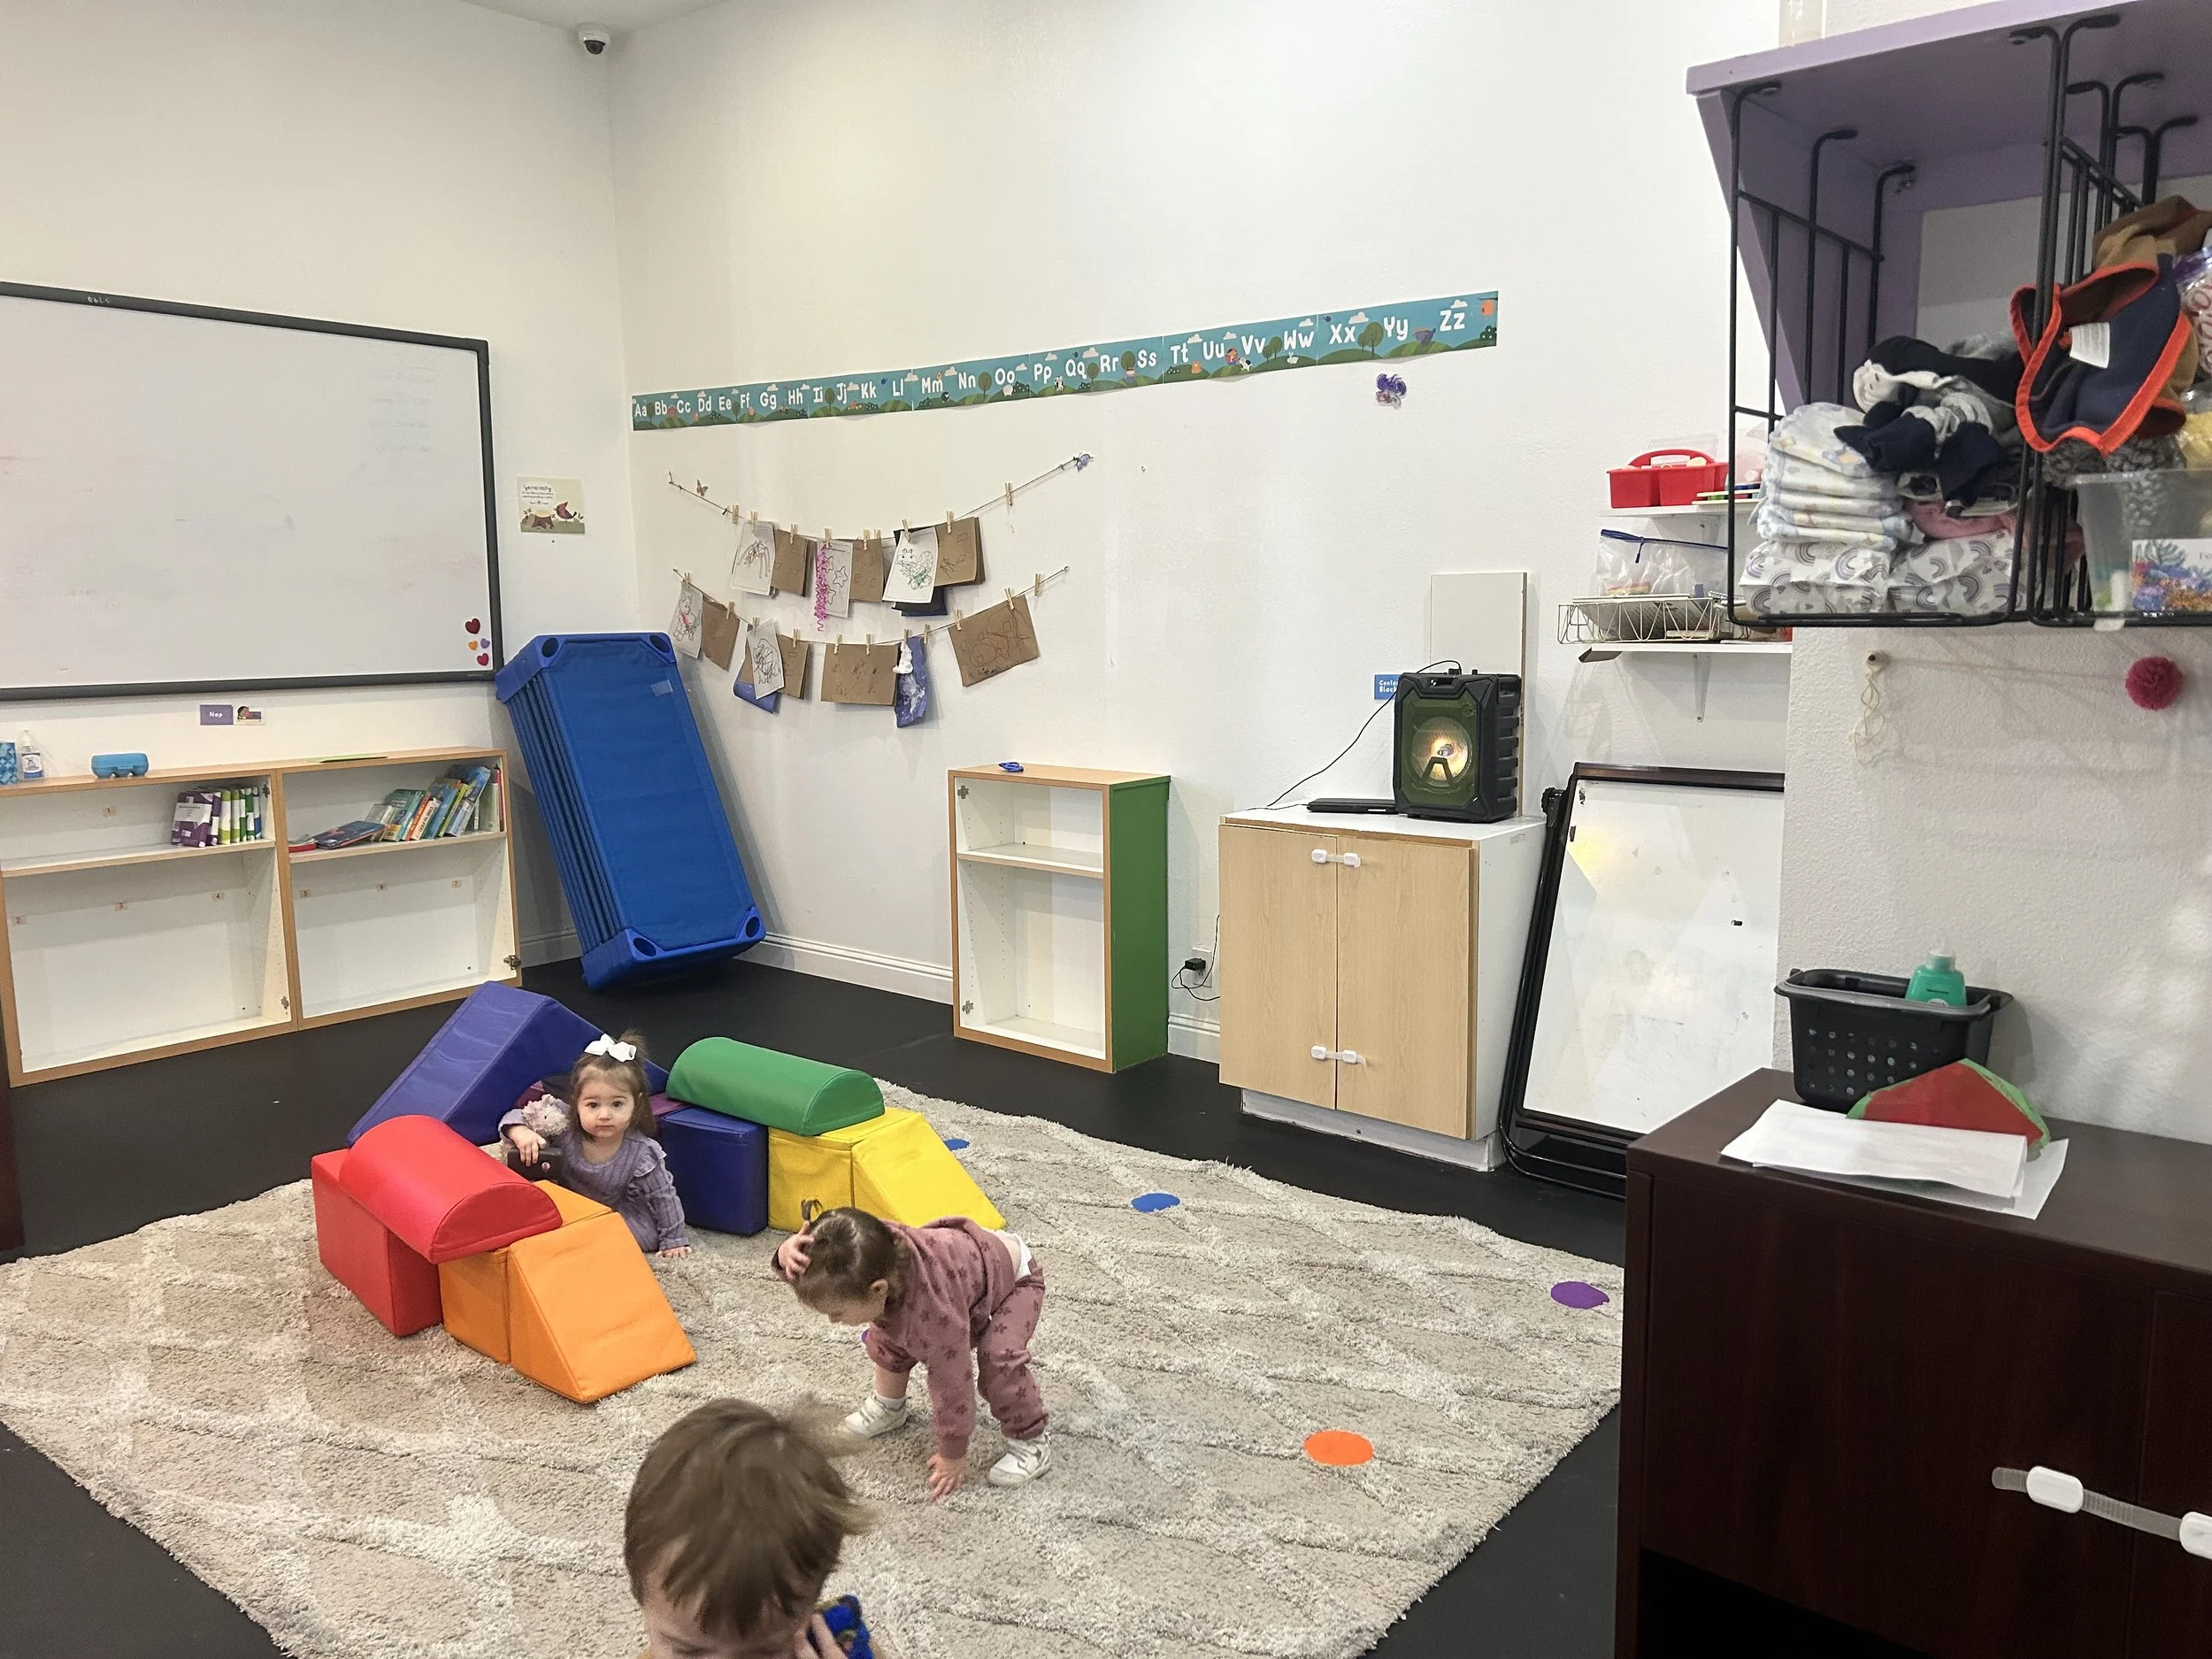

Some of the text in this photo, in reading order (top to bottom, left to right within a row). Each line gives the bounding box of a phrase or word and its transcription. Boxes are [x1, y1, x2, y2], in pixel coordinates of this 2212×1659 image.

[634, 310, 1465, 417] Aa Bb Cc Dd Ee Ff Gg Hh Ii Jj Kk Ll Mm Nn Oo Pp Qq Rr Ss Tt Uu Vv Ww Xx Yy Zz
